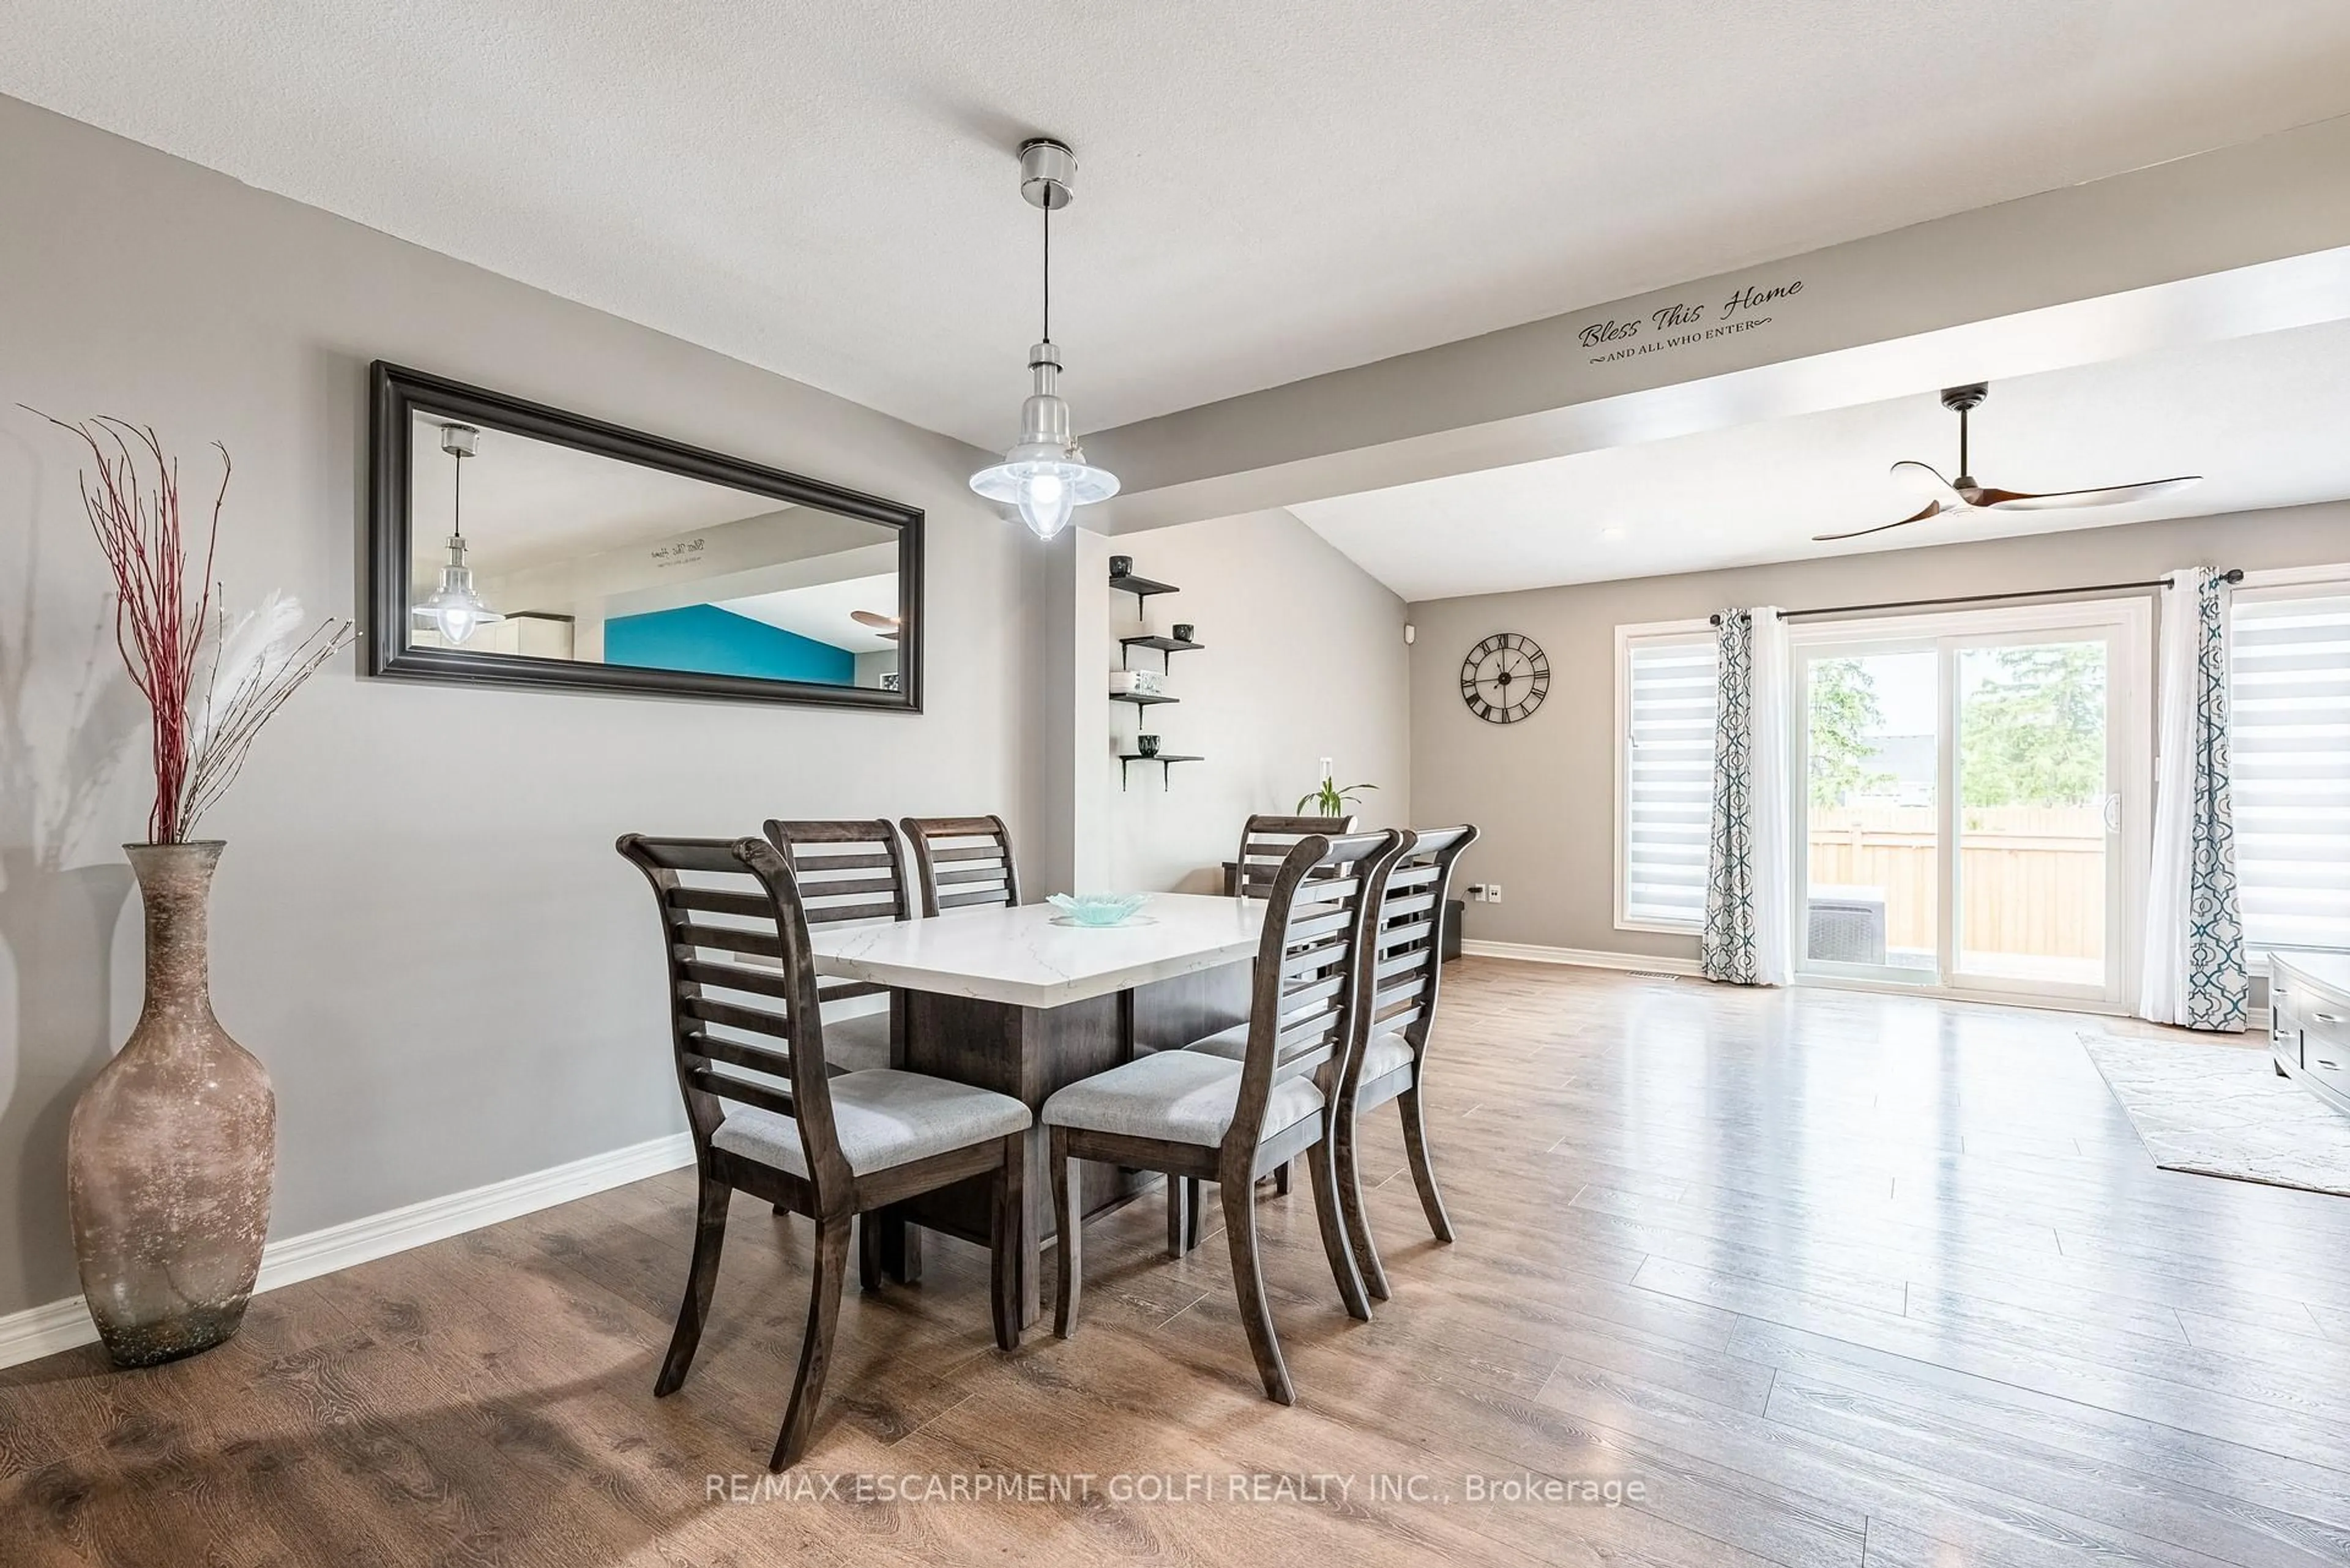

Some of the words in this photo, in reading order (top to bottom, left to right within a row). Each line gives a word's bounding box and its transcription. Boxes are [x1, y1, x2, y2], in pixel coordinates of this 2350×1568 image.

[1579, 321, 1641, 347] Bless
[1652, 304, 1704, 330] This
[1720, 280, 1804, 320] Home
[1607, 349, 1635, 362] AND
[1638, 343, 1664, 354] ALL
[1667, 332, 1701, 348] WHO
[1706, 320, 1755, 339] ENTER
